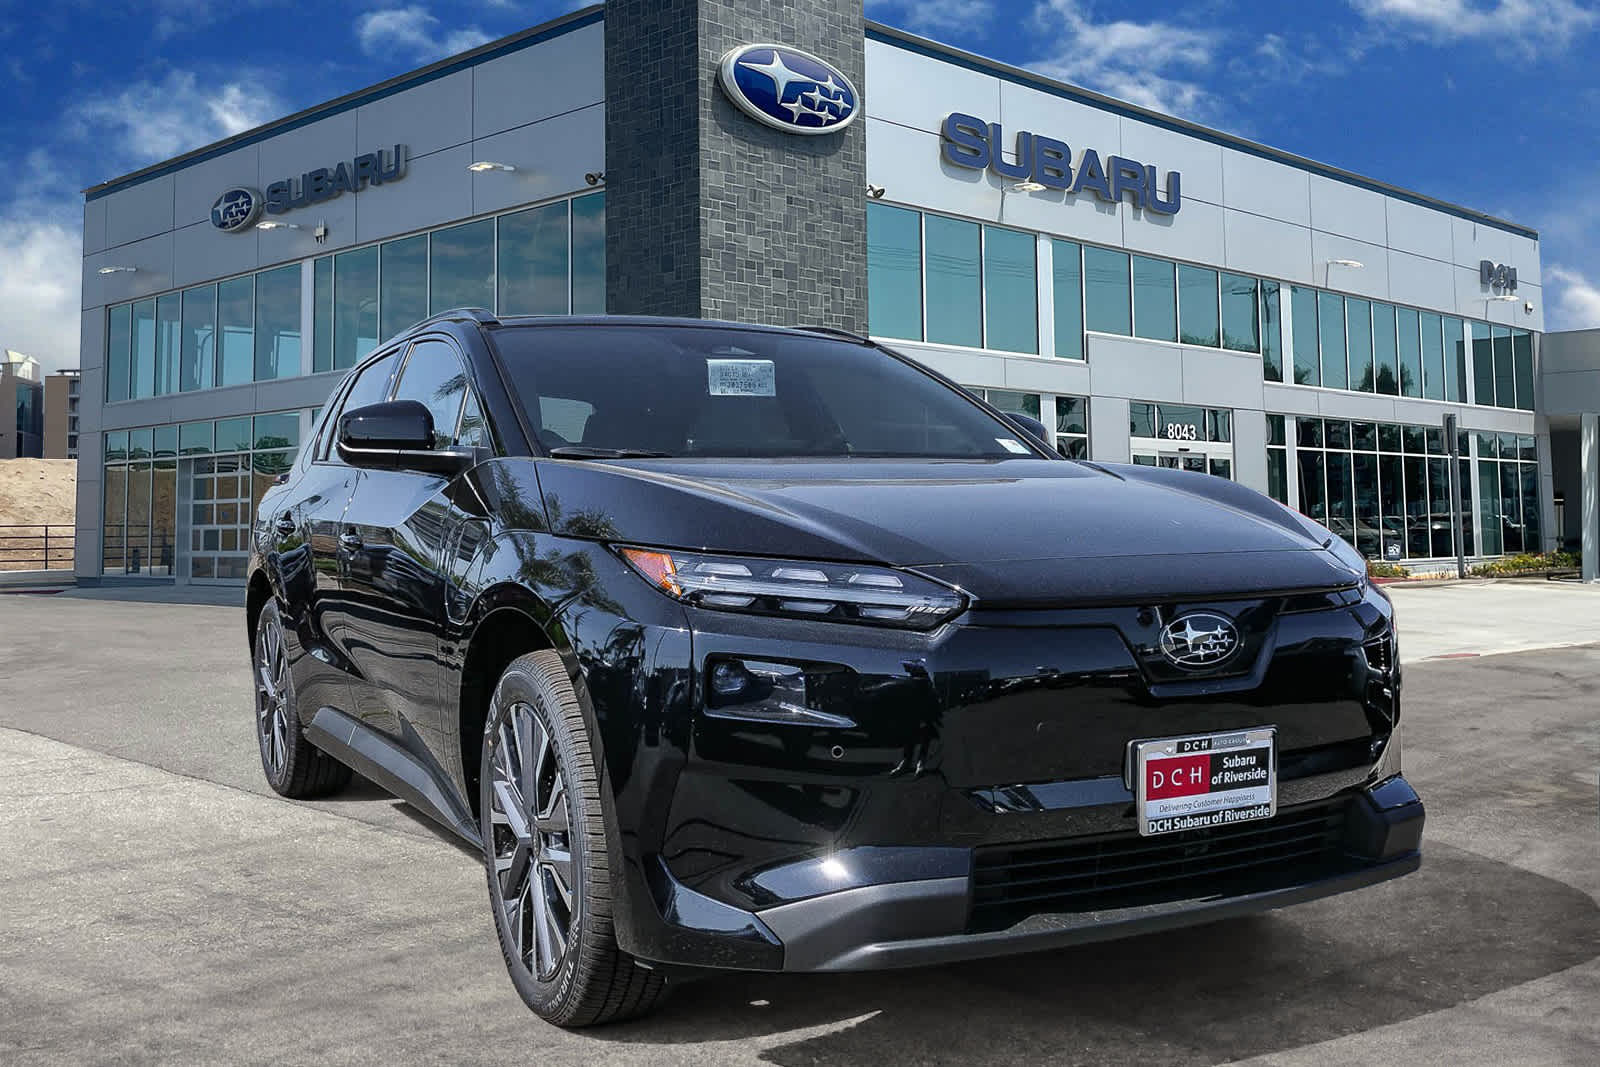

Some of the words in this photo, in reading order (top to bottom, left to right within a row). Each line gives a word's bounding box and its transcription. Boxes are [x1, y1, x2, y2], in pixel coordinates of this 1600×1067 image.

[942, 112, 1181, 215] SUBARU
[266, 144, 407, 214] SUBARU
[1167, 422, 1197, 440] 8043
[1184, 740, 1208, 752] DCH
[1222, 754, 1257, 768] Subaru
[1152, 766, 1203, 789] DCH
[1211, 771, 1223, 785] of
[1224, 767, 1267, 783] Riverside
[1159, 802, 1193, 813] Delivering
[1193, 798, 1223, 809] Customer
[1223, 792, 1256, 805] Happiness
[1149, 818, 1172, 833] DCH
[1174, 815, 1211, 830] Subaru
[1212, 810, 1225, 823] of
[1224, 805, 1270, 822] Riverside
